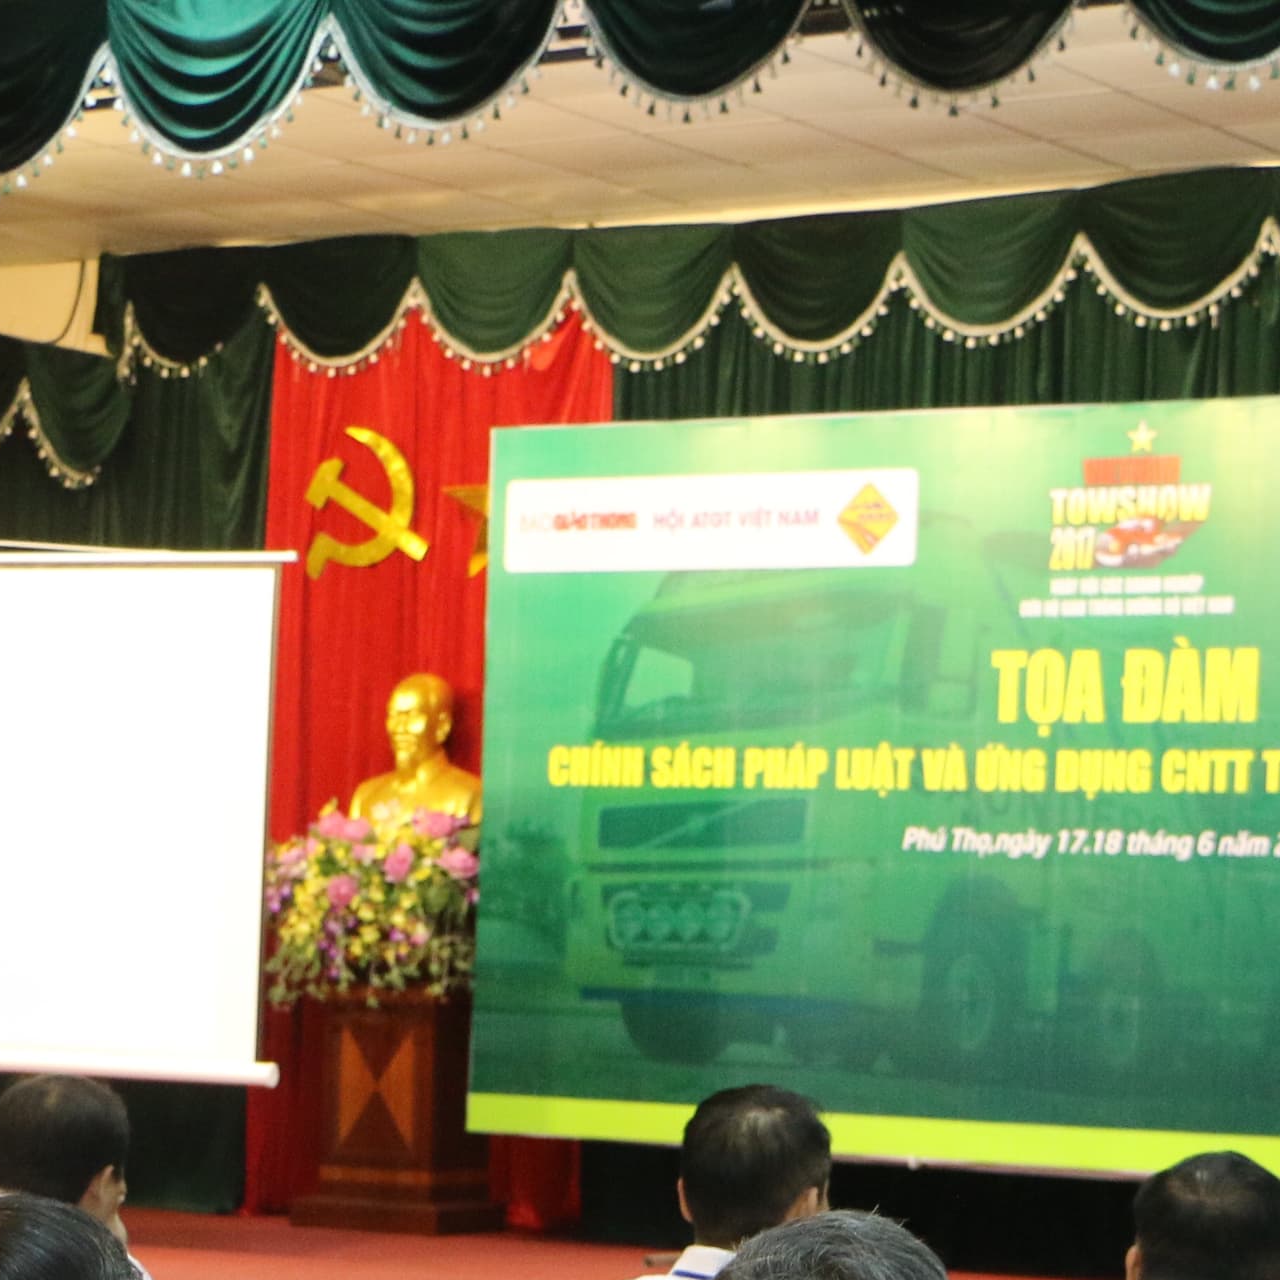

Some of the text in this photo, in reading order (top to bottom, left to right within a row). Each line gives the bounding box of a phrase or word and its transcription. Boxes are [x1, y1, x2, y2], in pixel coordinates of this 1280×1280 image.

[1049, 484, 1211, 525] TOWSHOW
[992, 637, 1259, 736] TỌA ĐÀM
[548, 741, 644, 788] CHÍNH
[651, 741, 735, 788] SÁCH
[744, 742, 828, 790] PHÁP
[834, 741, 915, 797] LUẬT
[922, 742, 968, 792] VÀ
[976, 742, 1047, 793] ỨNG
[1056, 749, 1150, 799] DỤNG
[1161, 750, 1255, 793] CNTT
[902, 826, 945, 853] Phú
[1056, 828, 1122, 856] 17.18
[1127, 830, 1192, 861] tháng
[1197, 833, 1215, 857] 6
[1219, 833, 1270, 858] năm
